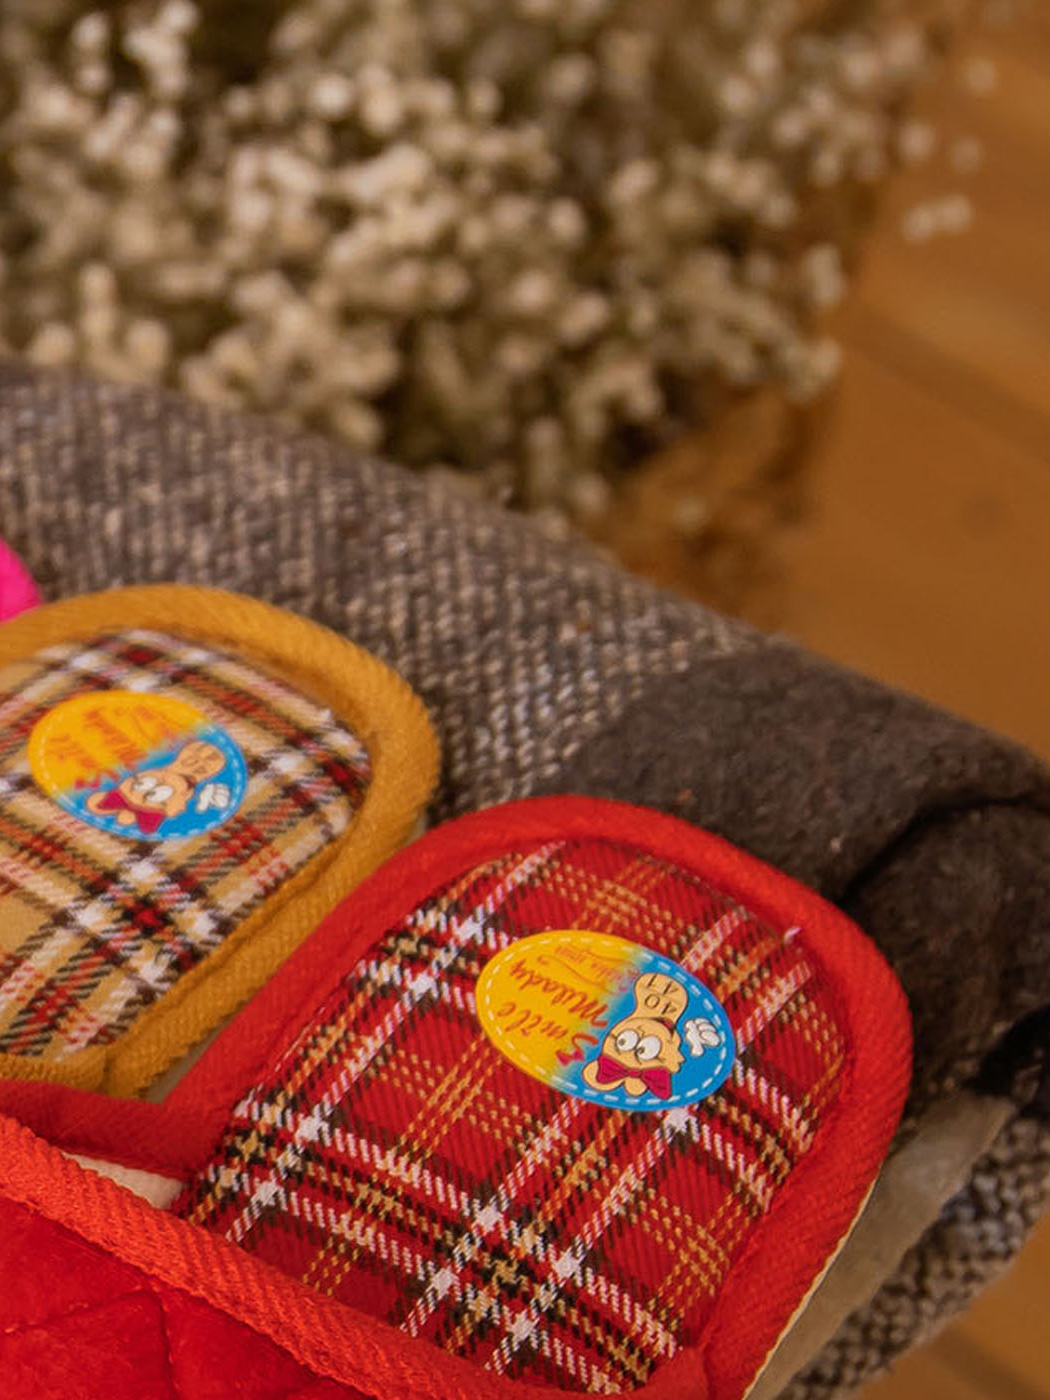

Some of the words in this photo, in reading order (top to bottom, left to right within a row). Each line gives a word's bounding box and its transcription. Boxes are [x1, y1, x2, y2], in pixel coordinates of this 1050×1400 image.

[508, 960, 609, 1028] Milady
[644, 993, 679, 1015] 40
[497, 1001, 599, 1067] Smile
